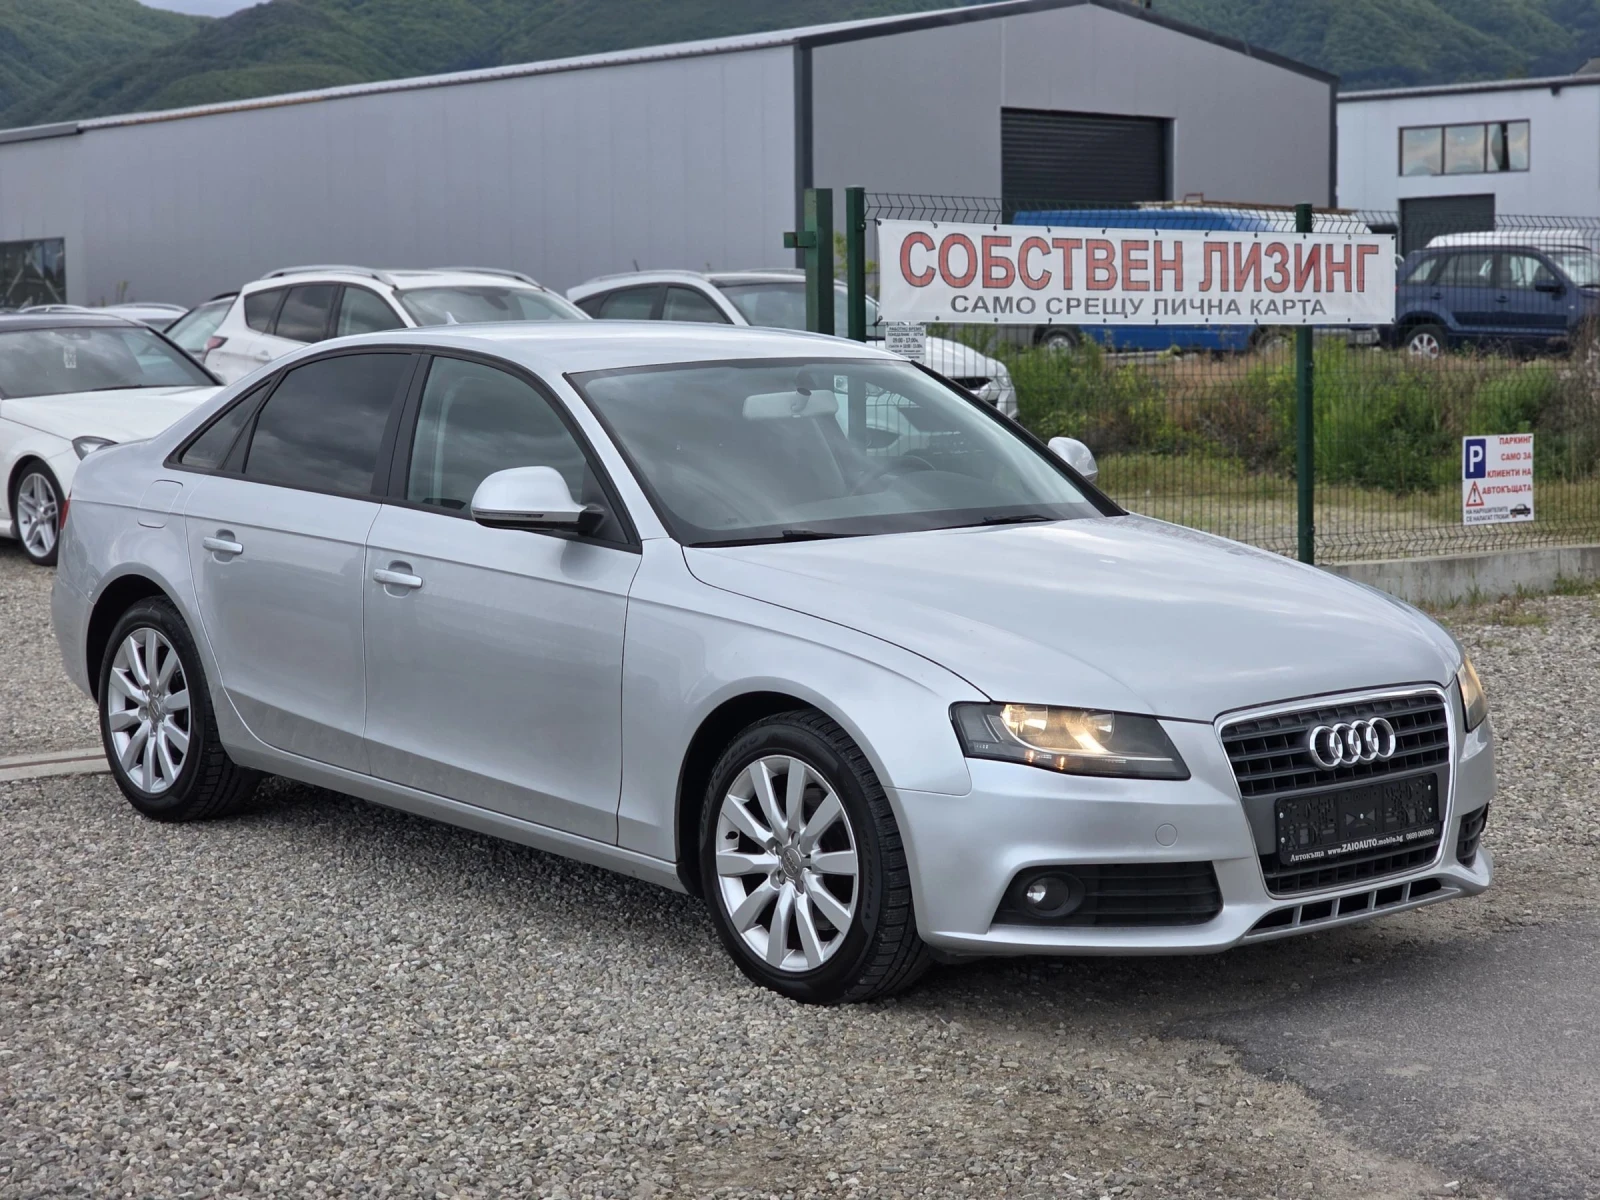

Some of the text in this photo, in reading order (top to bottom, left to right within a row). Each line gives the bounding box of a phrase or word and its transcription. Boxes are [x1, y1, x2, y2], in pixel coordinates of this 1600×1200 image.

[900, 231, 1379, 294] СОБСТВЕН ЛИЗИНГ
[950, 295, 1327, 317] САМО СРЕЩУ ЛИЧНА КАРТА
[1499, 436, 1532, 445] ПАРКИНГ
[1469, 445, 1484, 473] P
[1501, 452, 1532, 461] САМО ЗА
[1487, 468, 1532, 478] КЛИЕНТИ НА
[1482, 484, 1532, 495] АВТОКЪЩАТА
[1290, 850, 1325, 862] Автокъща
